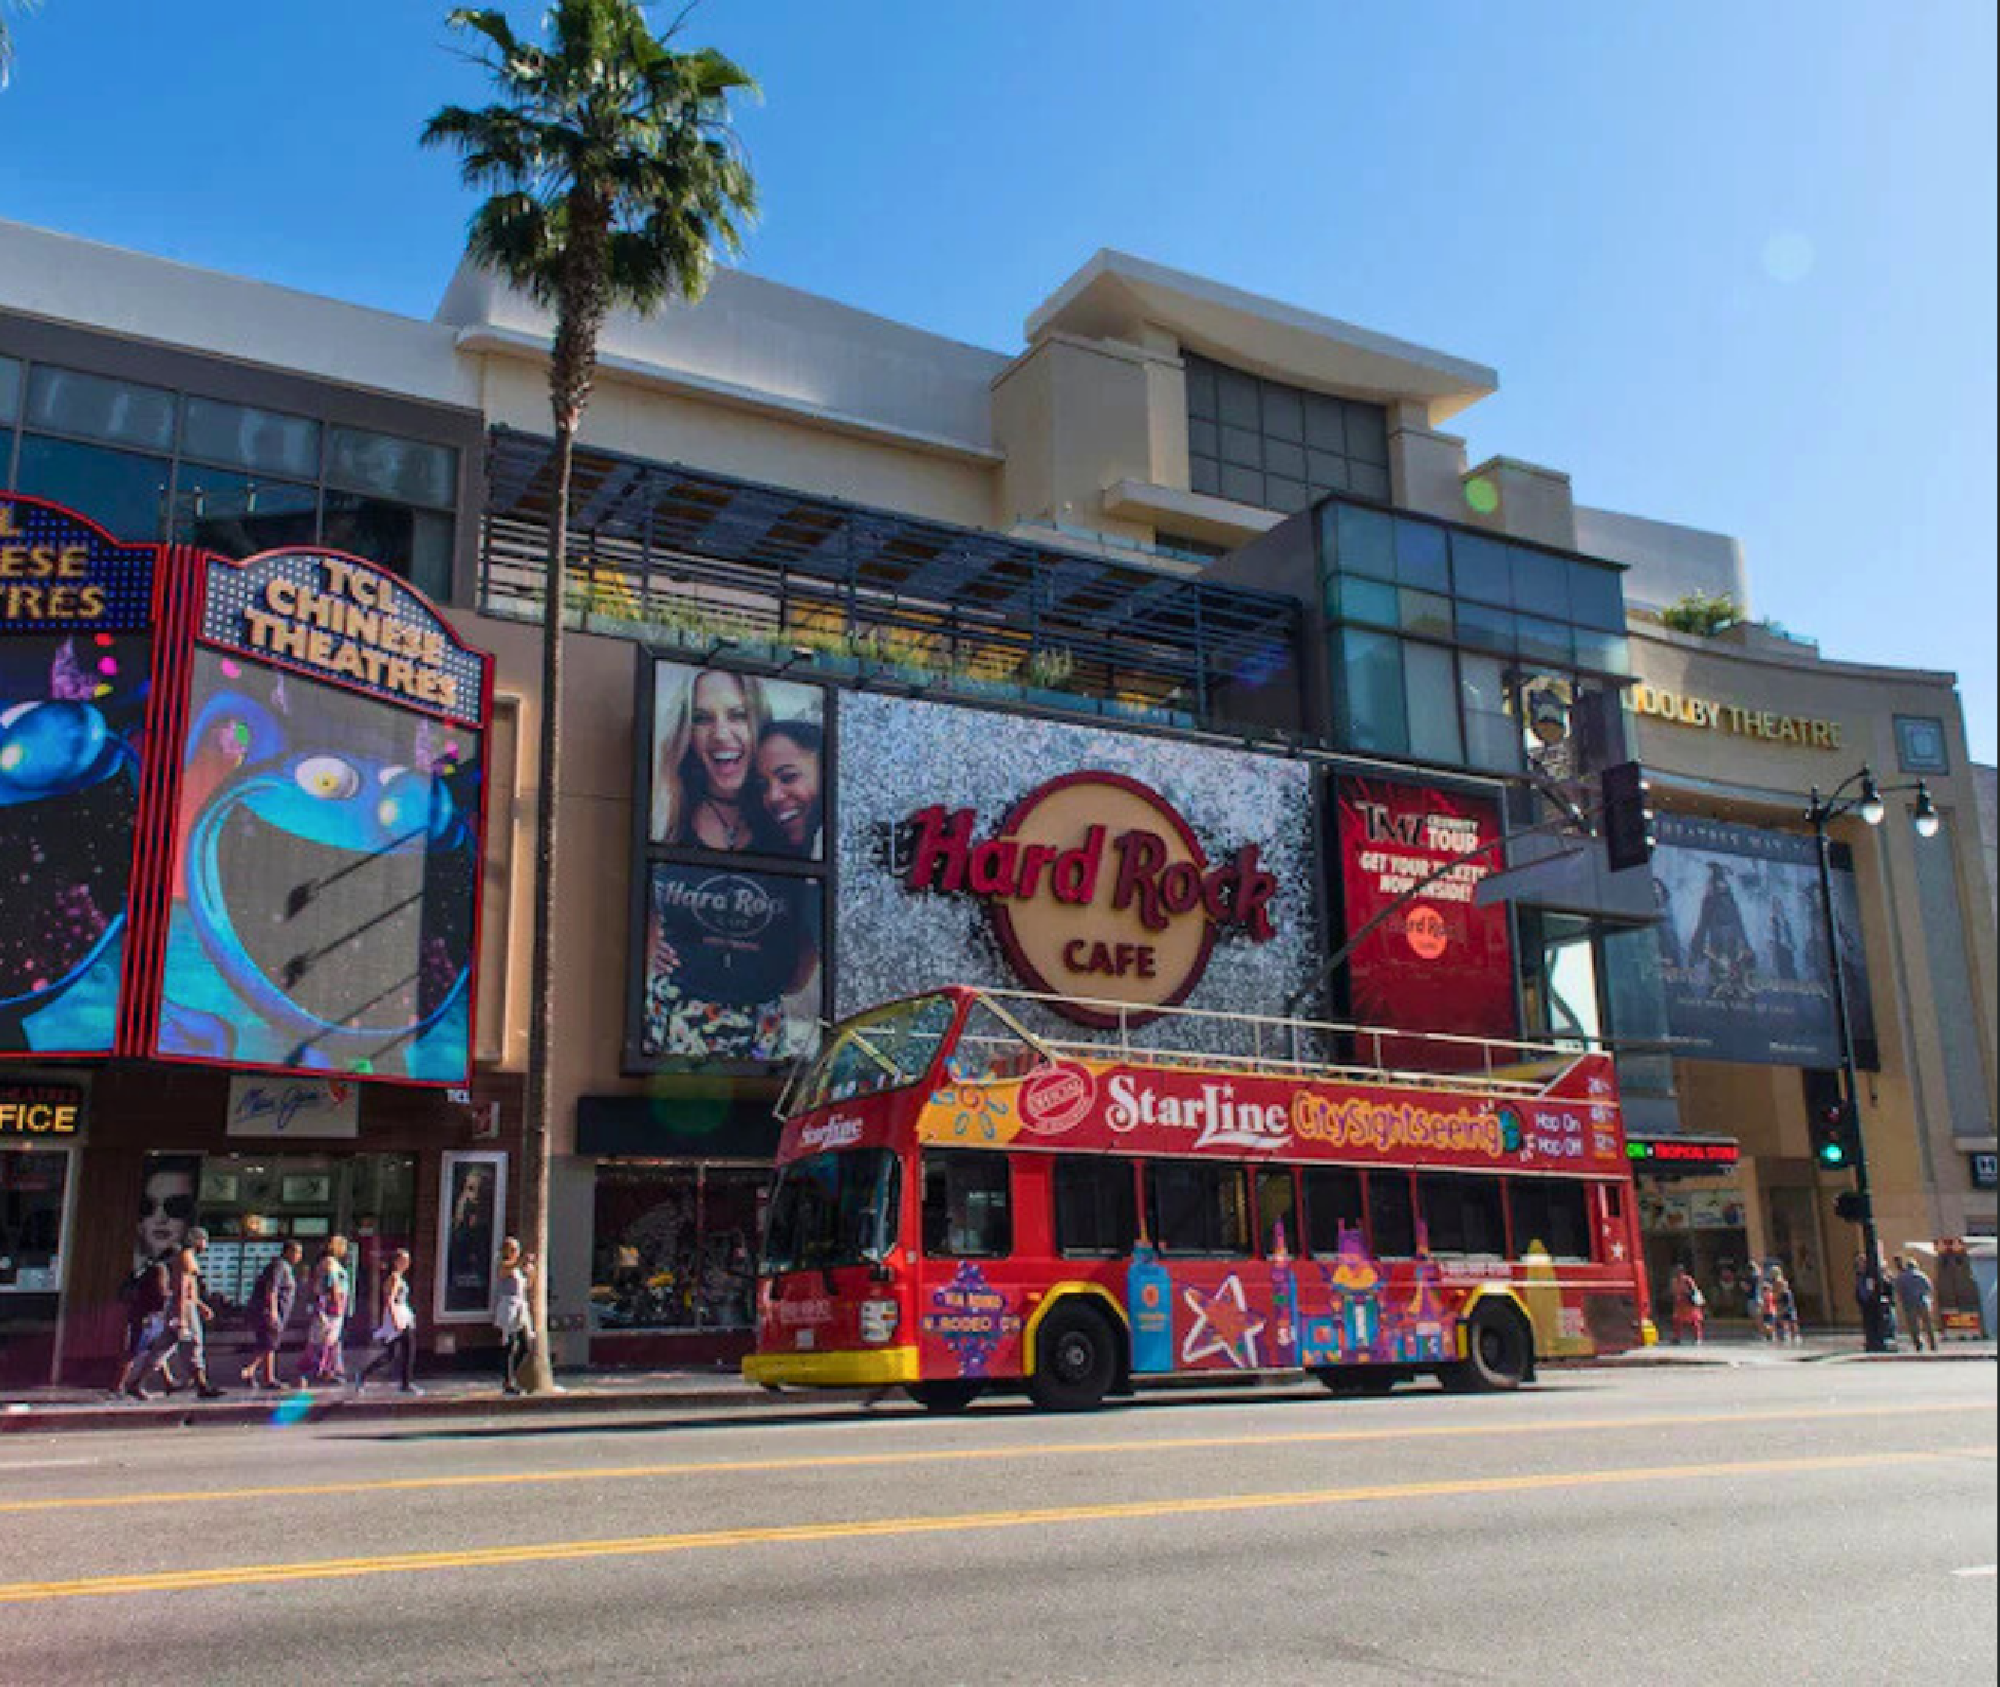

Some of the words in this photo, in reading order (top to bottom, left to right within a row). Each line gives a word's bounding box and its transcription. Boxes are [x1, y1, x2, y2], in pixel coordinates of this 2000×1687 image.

[0, 585, 105, 619] RES
[322, 557, 397, 615] TCL
[266, 577, 445, 667] CHINESE
[243, 607, 457, 707] THEATRES
[1633, 684, 1720, 729] DOLBY
[1727, 704, 1842, 748] THEATRE
[1427, 828, 1480, 854] TOUR
[908, 804, 1106, 904] Hard
[1112, 829, 1278, 943] Rock
[1359, 851, 1386, 873] GET
[1389, 856, 1429, 877] YOUR
[1063, 939, 1156, 978] CAFE
[0, 1103, 78, 1132] FICE
[1105, 1075, 1293, 1148] StarLine
[1535, 1112, 1560, 1132] Hop
[1538, 1136, 1562, 1157] Hop
